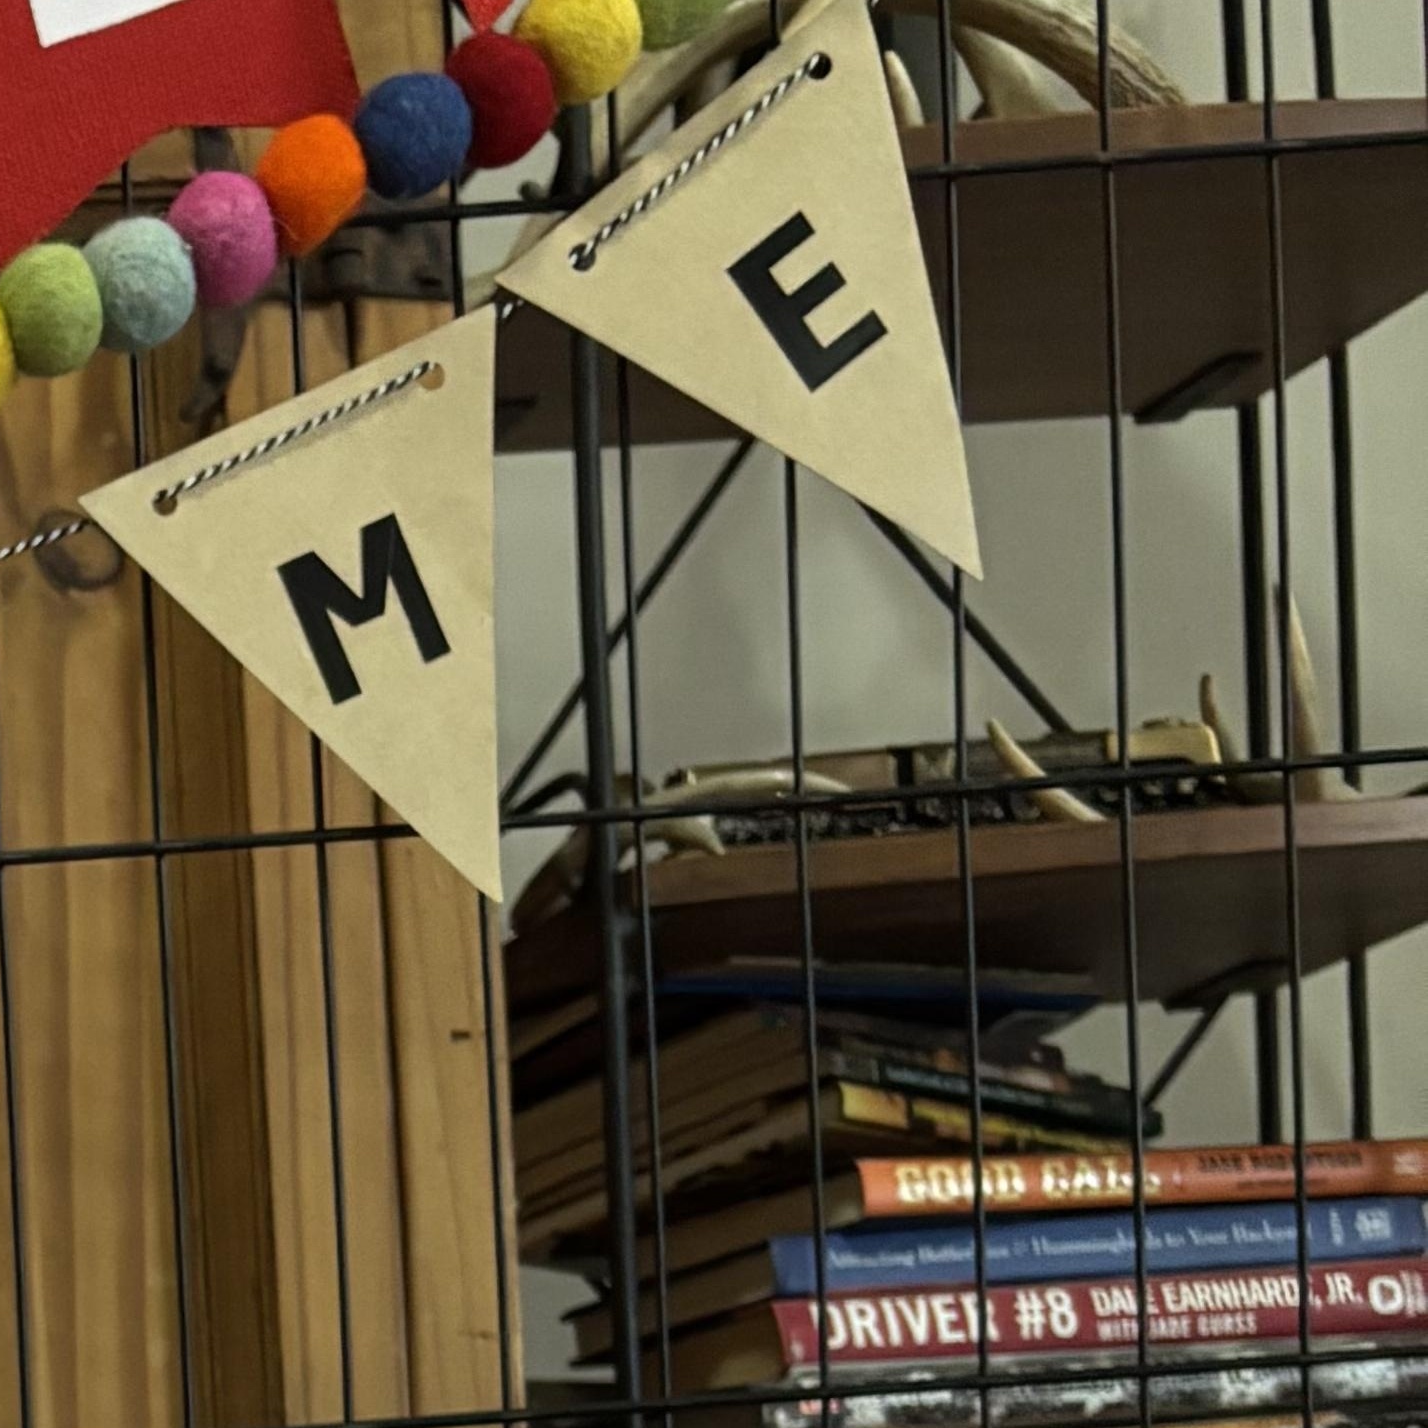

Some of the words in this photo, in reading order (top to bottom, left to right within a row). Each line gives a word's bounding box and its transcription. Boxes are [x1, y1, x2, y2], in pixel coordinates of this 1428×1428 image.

[277, 210, 889, 706] ME
[894, 1159, 1026, 1204] GOOD
[808, 1291, 1001, 1351] DRIVER
[1014, 1286, 1080, 1341] #8
[1090, 1282, 1160, 1318] DALE
[1324, 1271, 1365, 1306] JR.
